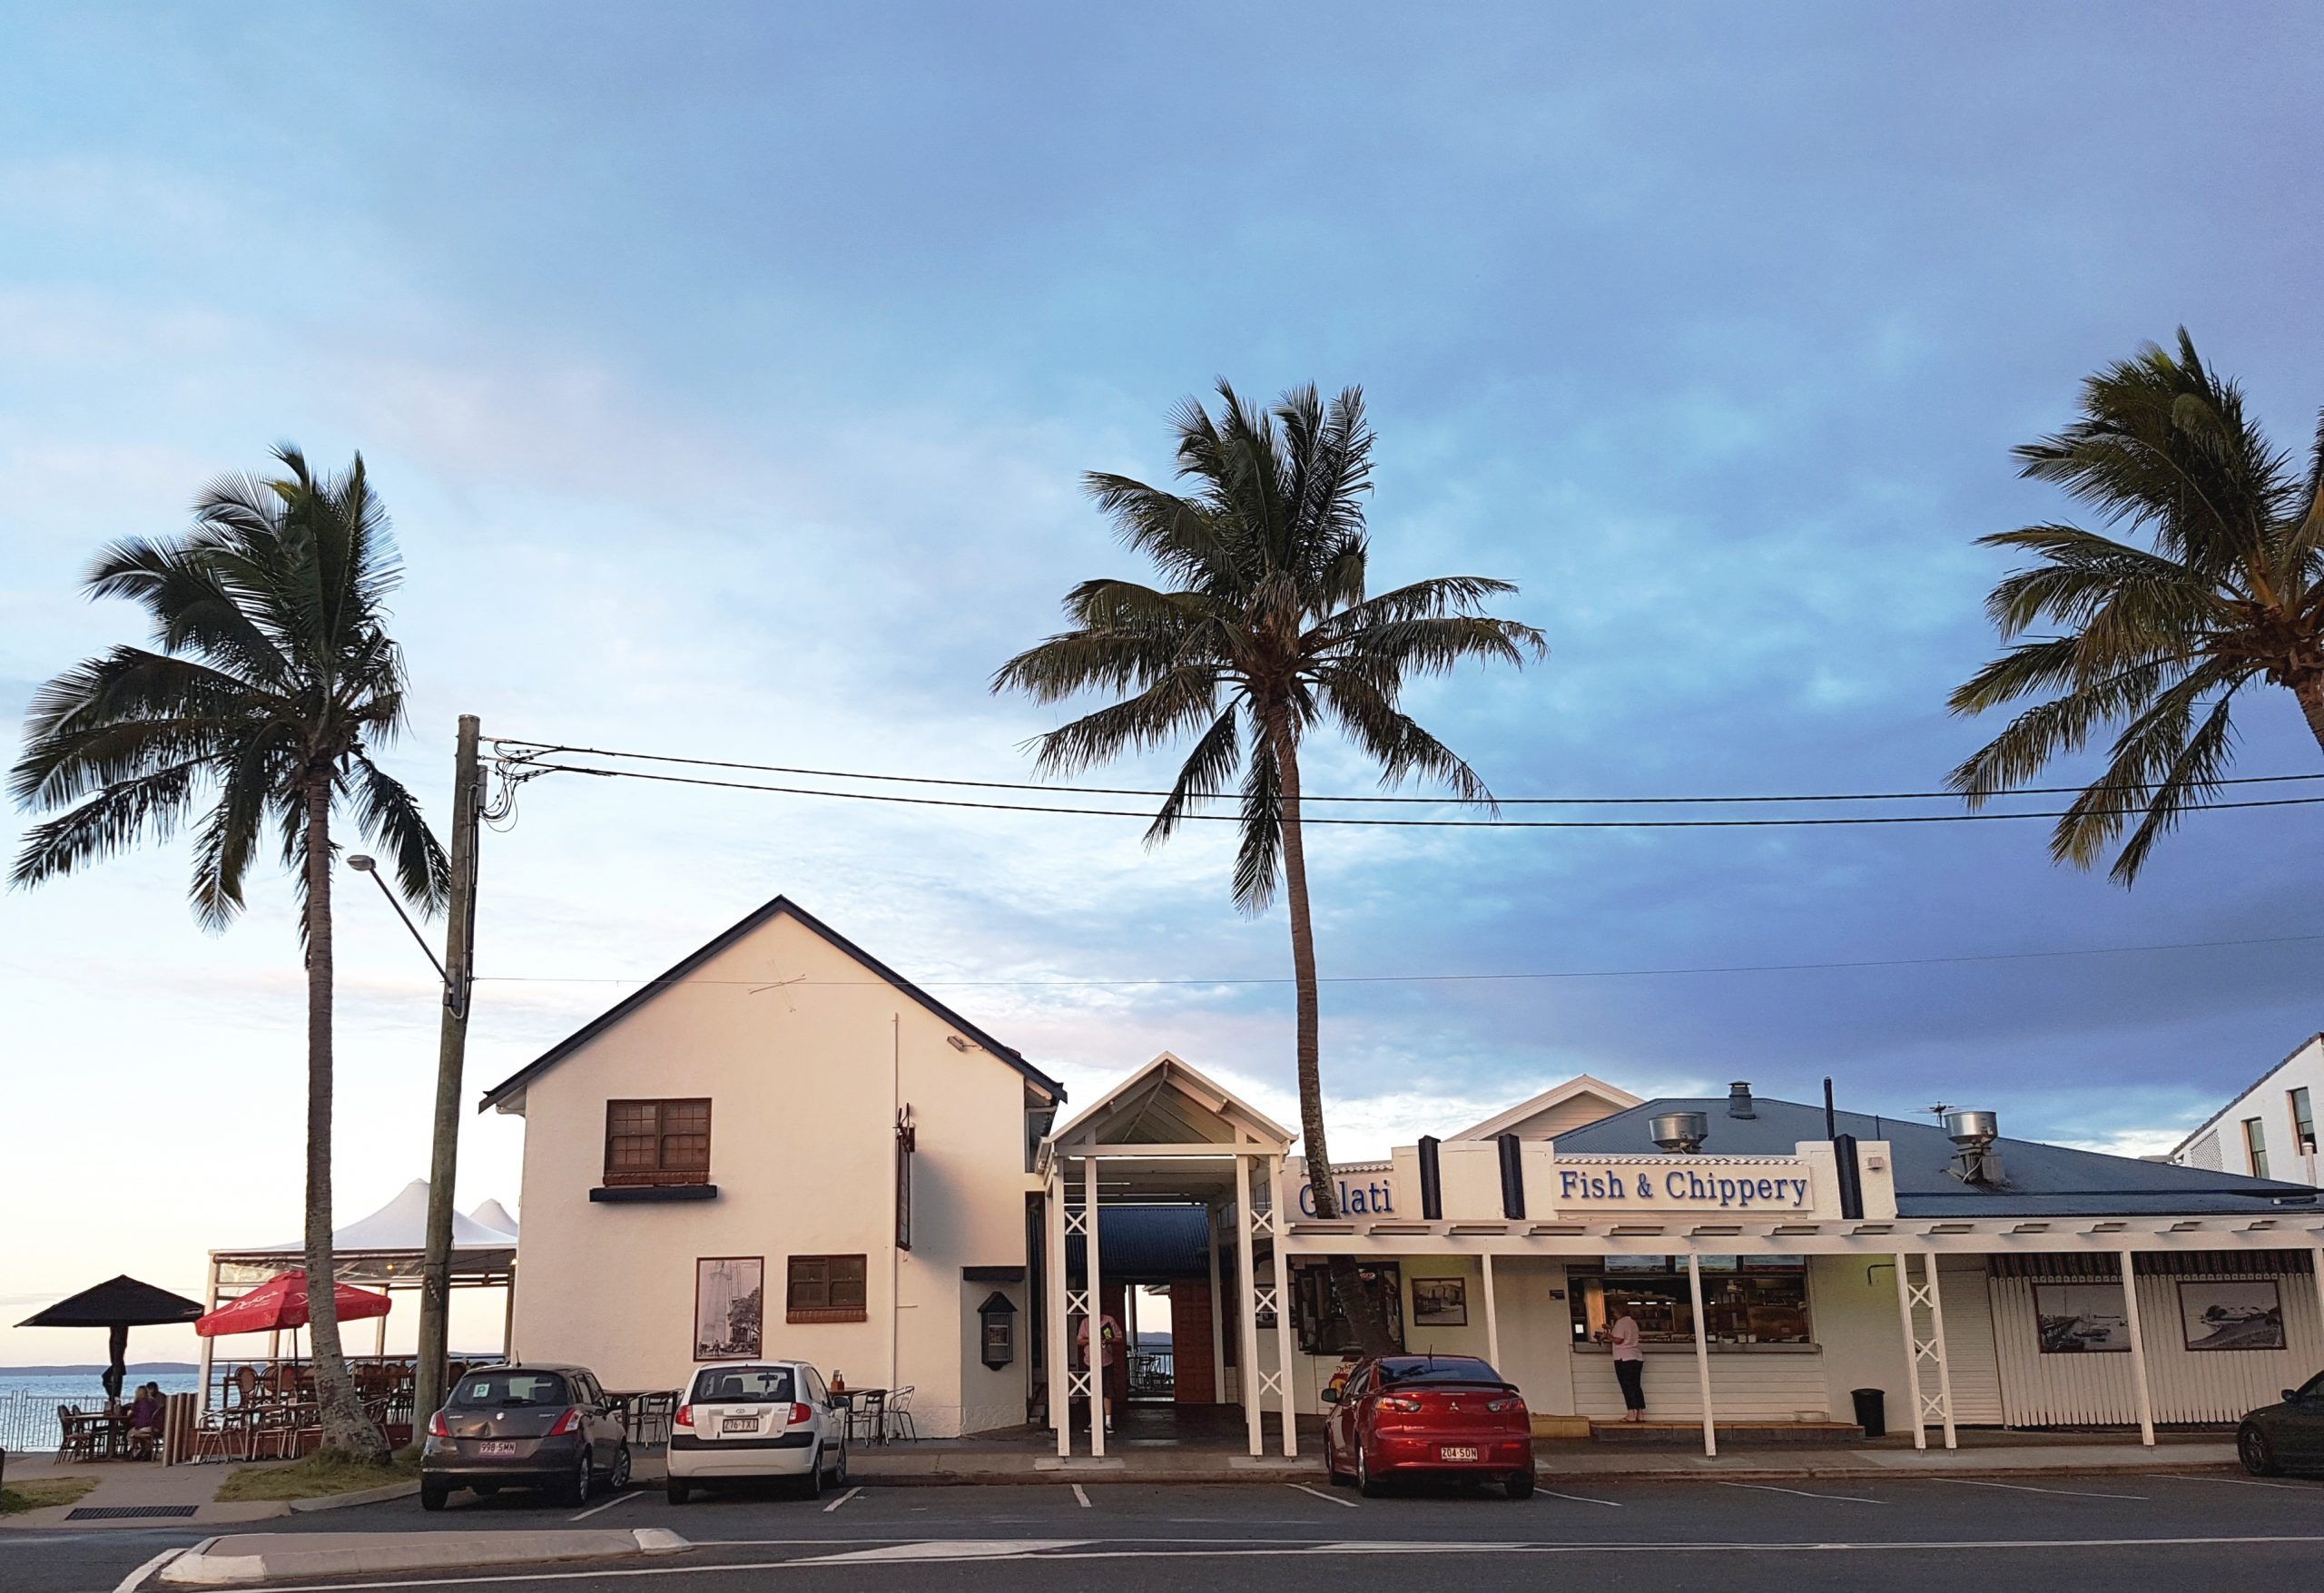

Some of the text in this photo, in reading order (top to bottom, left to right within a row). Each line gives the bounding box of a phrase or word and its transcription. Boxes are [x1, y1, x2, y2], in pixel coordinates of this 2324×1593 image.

[1298, 1179, 1395, 1217] Glati
[1559, 1170, 1807, 1207] Fish & Chippery
